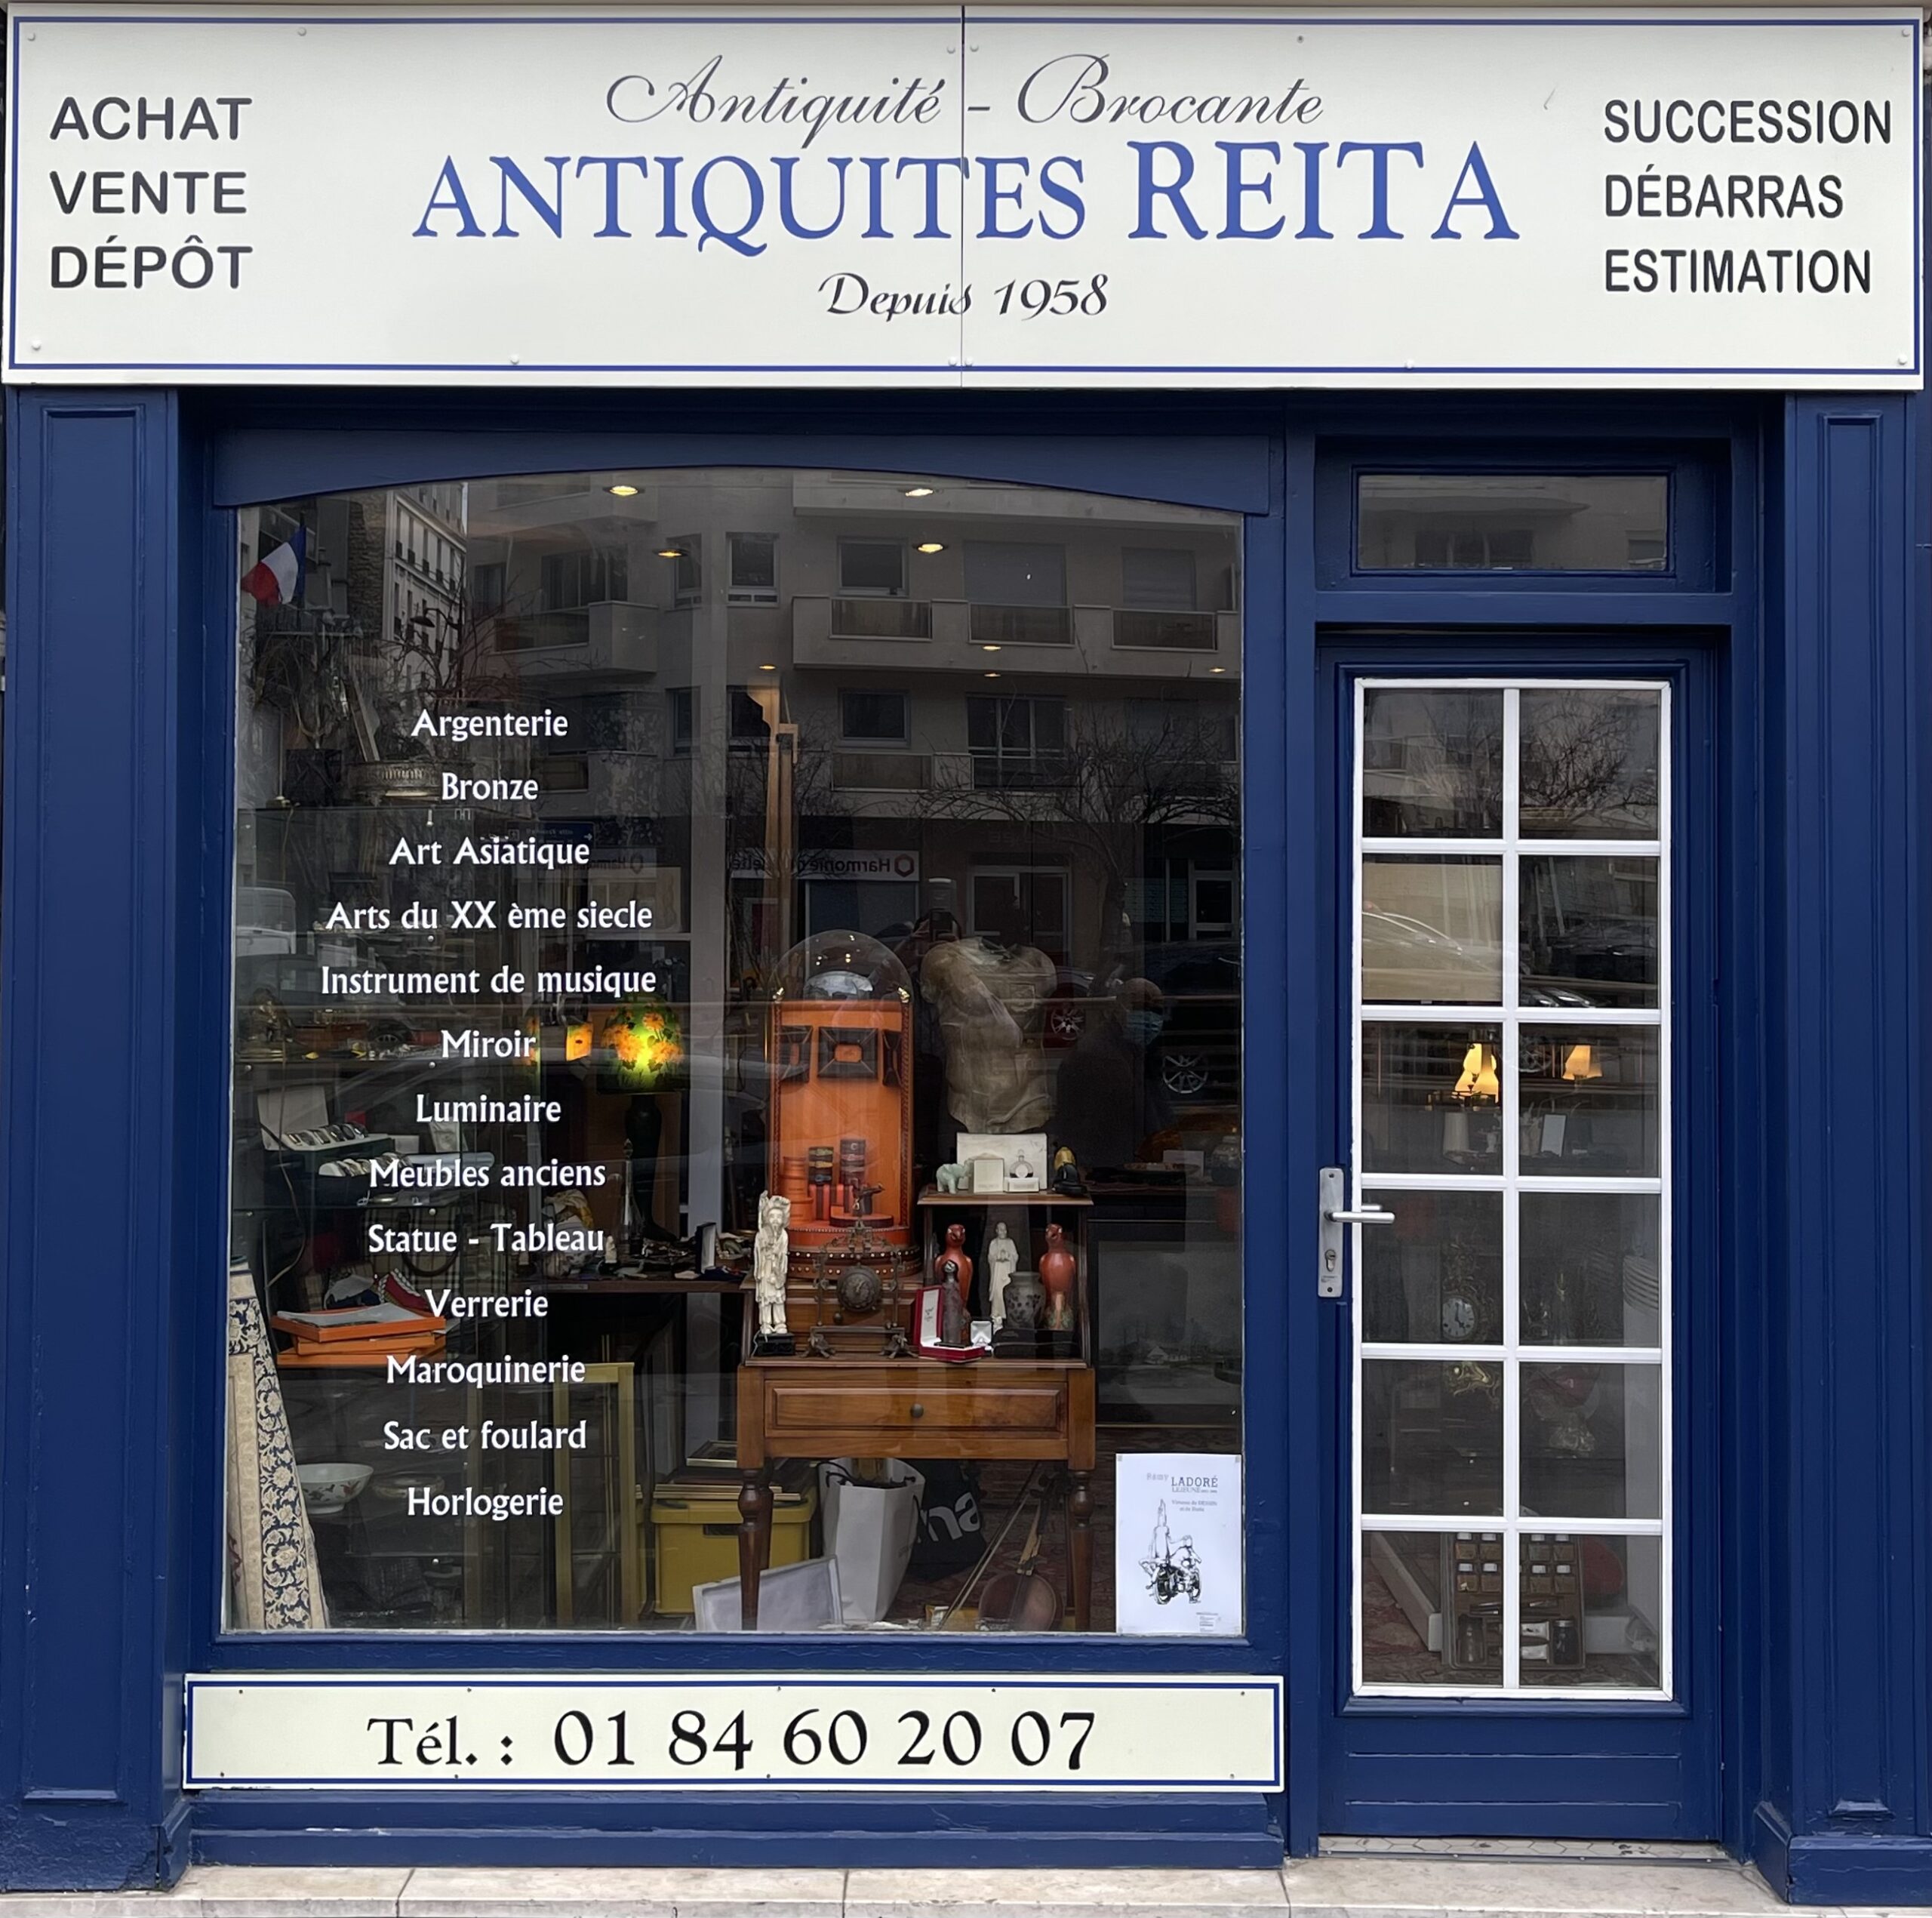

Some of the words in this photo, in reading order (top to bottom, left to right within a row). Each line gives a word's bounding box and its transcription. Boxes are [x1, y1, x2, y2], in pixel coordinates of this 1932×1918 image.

[50, 97, 253, 140] ACHAT
[607, 54, 944, 149] Antiquité
[1018, 54, 1323, 124] Brocante
[1604, 99, 1890, 144] SUCCESSION
[49, 171, 247, 214] VENTE
[415, 152, 1084, 257] ANTIQUITES
[1129, 141, 1518, 239] REITA
[1605, 163, 1843, 219] DÉBARRAS
[51, 235, 253, 289] DÉPÔT
[1605, 248, 1870, 294] ESTIMATION
[818, 272, 972, 322] Depuis
[995, 274, 1108, 319] 1958
[411, 709, 568, 742] Argenterie
[442, 772, 538, 800] Bronze
[389, 837, 442, 865] Art
[453, 836, 589, 870] Asiatique
[325, 902, 390, 929] Arts
[401, 901, 438, 929] du
[451, 901, 497, 928] XX
[508, 903, 566, 928] ème
[577, 901, 652, 928] siecle
[322, 966, 480, 994] Instrument
[491, 965, 525, 993] de
[537, 965, 656, 998] musique
[441, 1030, 537, 1058] Miroir
[417, 1094, 561, 1122] Luminaire
[369, 1158, 489, 1187] Meubles
[500, 1158, 605, 1187] anciens
[369, 1224, 457, 1252] Statue
[490, 1223, 604, 1251] Tableau
[424, 1288, 548, 1317] Verrerie
[386, 1354, 586, 1389] Maroquinerie
[384, 1421, 430, 1450] Sac
[441, 1426, 469, 1449] et
[481, 1420, 586, 1449] foulard
[1171, 1476, 1218, 1487] LADORÉ
[408, 1487, 563, 1521] Horlogerie
[367, 1715, 478, 1766] Tél.
[554, 1710, 635, 1766] 01
[669, 1710, 753, 1771] 84
[783, 1708, 867, 1766] 60
[897, 1710, 982, 1766] 20
[1011, 1710, 1095, 1770] 07
